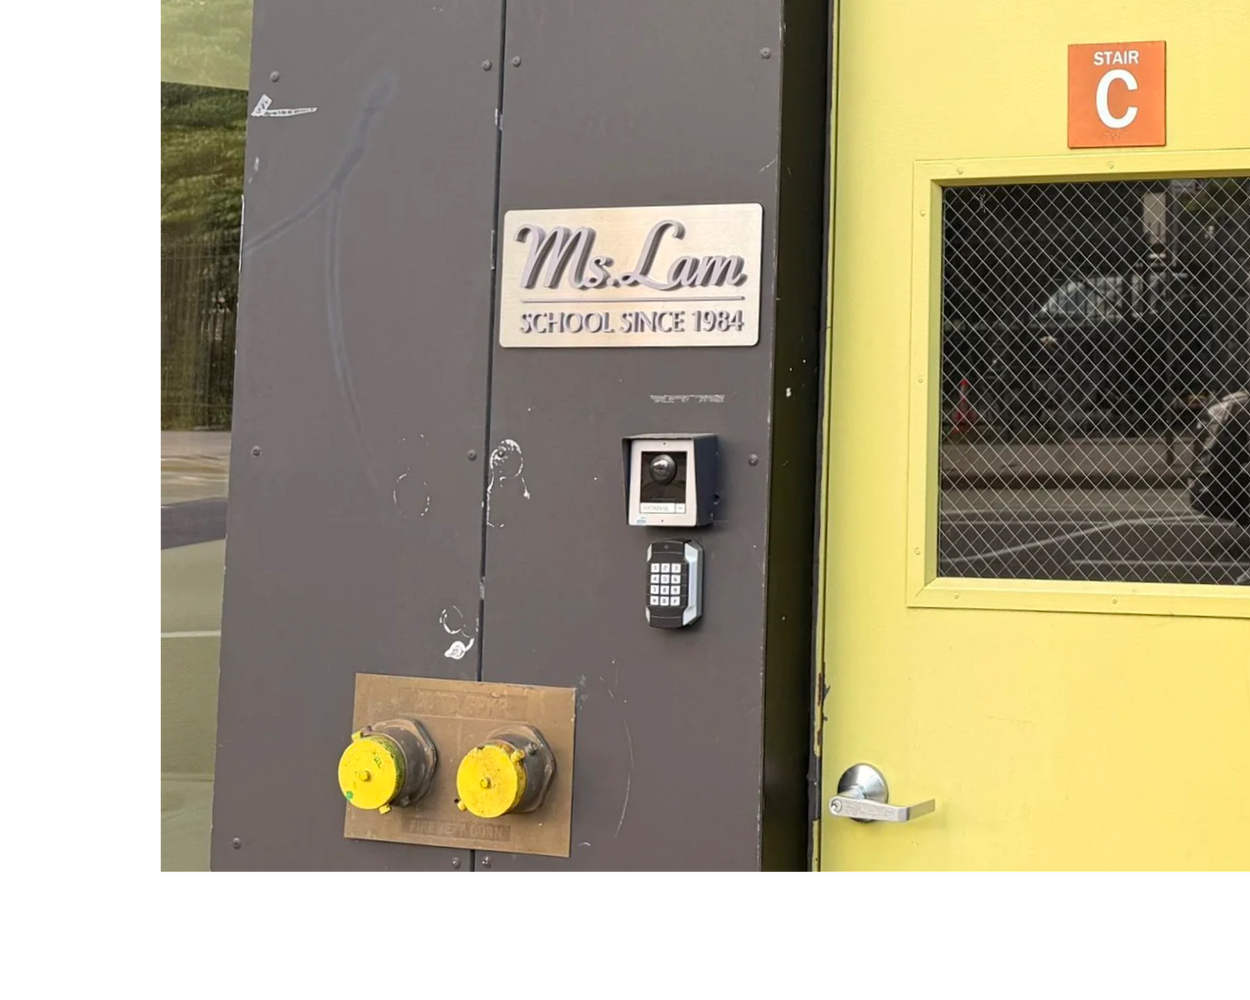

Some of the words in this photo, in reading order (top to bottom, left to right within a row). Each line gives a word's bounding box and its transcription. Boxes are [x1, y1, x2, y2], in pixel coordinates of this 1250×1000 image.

[1093, 50, 1140, 66] STAIR
[1095, 68, 1138, 129] C
[519, 311, 615, 334] SCHOOL
[619, 310, 686, 333] SINCE
[691, 309, 745, 332] 1984
